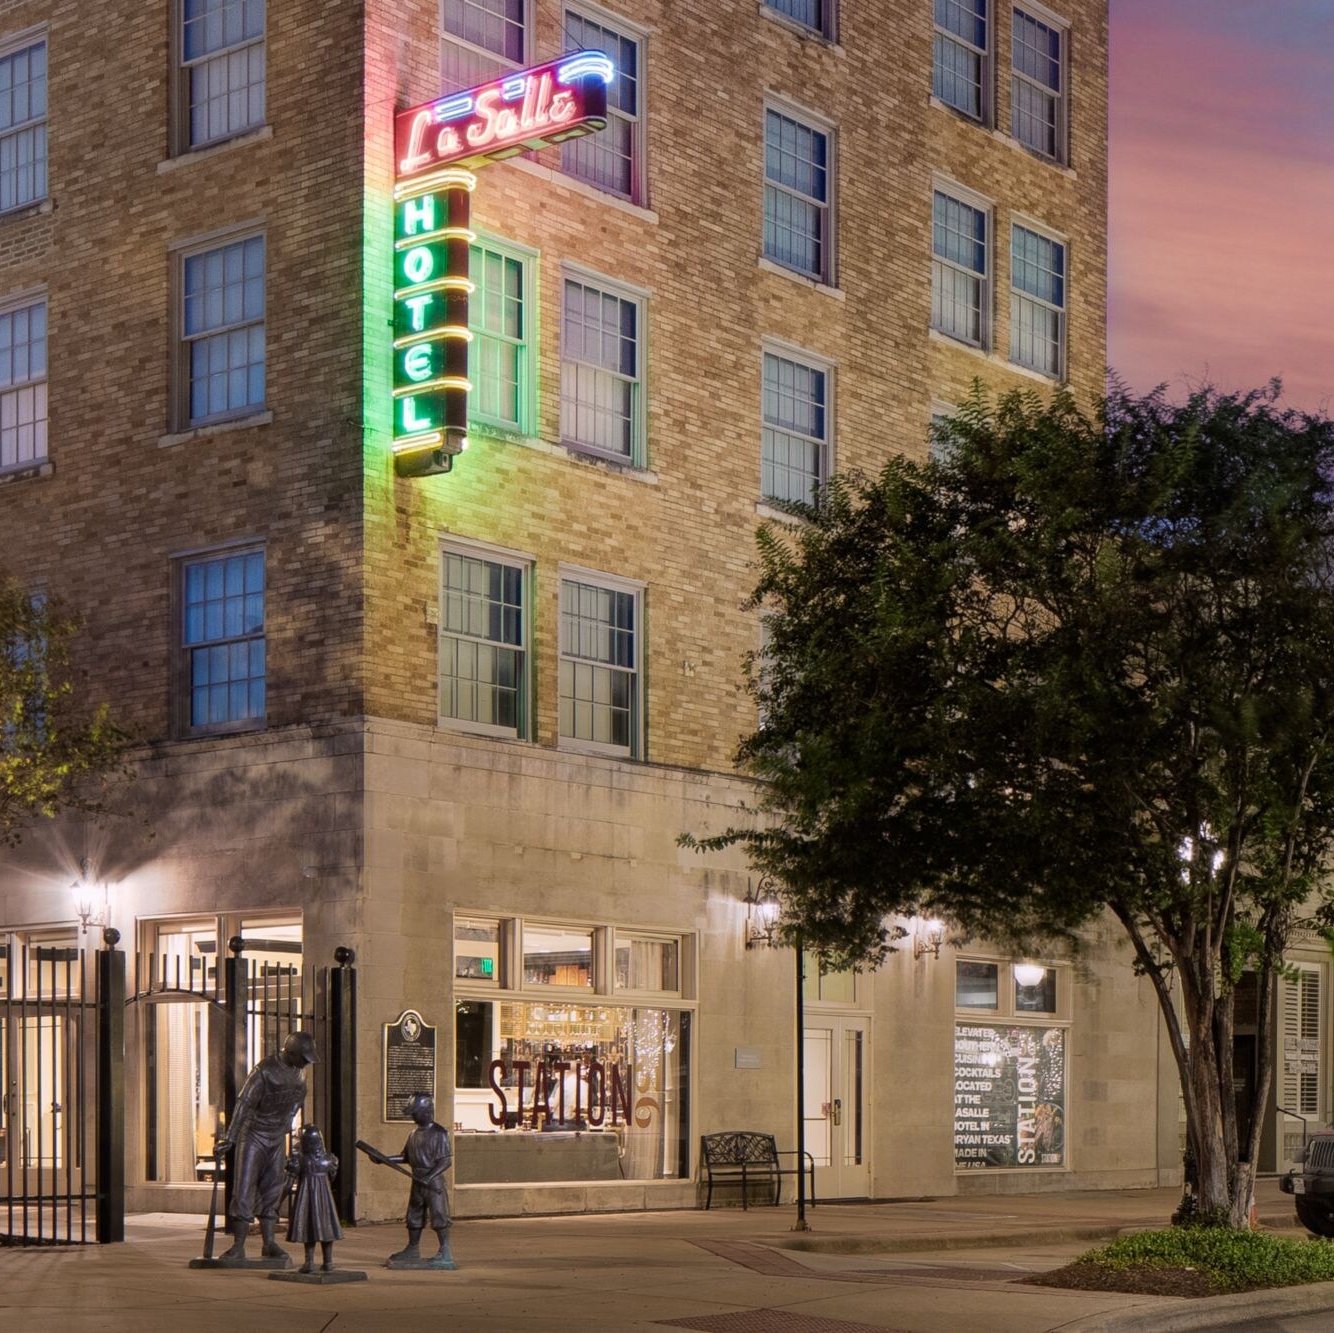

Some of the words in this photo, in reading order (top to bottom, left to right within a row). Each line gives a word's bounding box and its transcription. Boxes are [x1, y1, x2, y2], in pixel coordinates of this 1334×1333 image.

[402, 193, 435, 433] HOTEL
[488, 1059, 632, 1126] STATION
[955, 1081, 992, 1091] OCATED
[955, 1108, 989, 1118] ASALLE
[955, 1121, 980, 1131] OTEL
[1017, 1056, 1036, 1164] STATION
